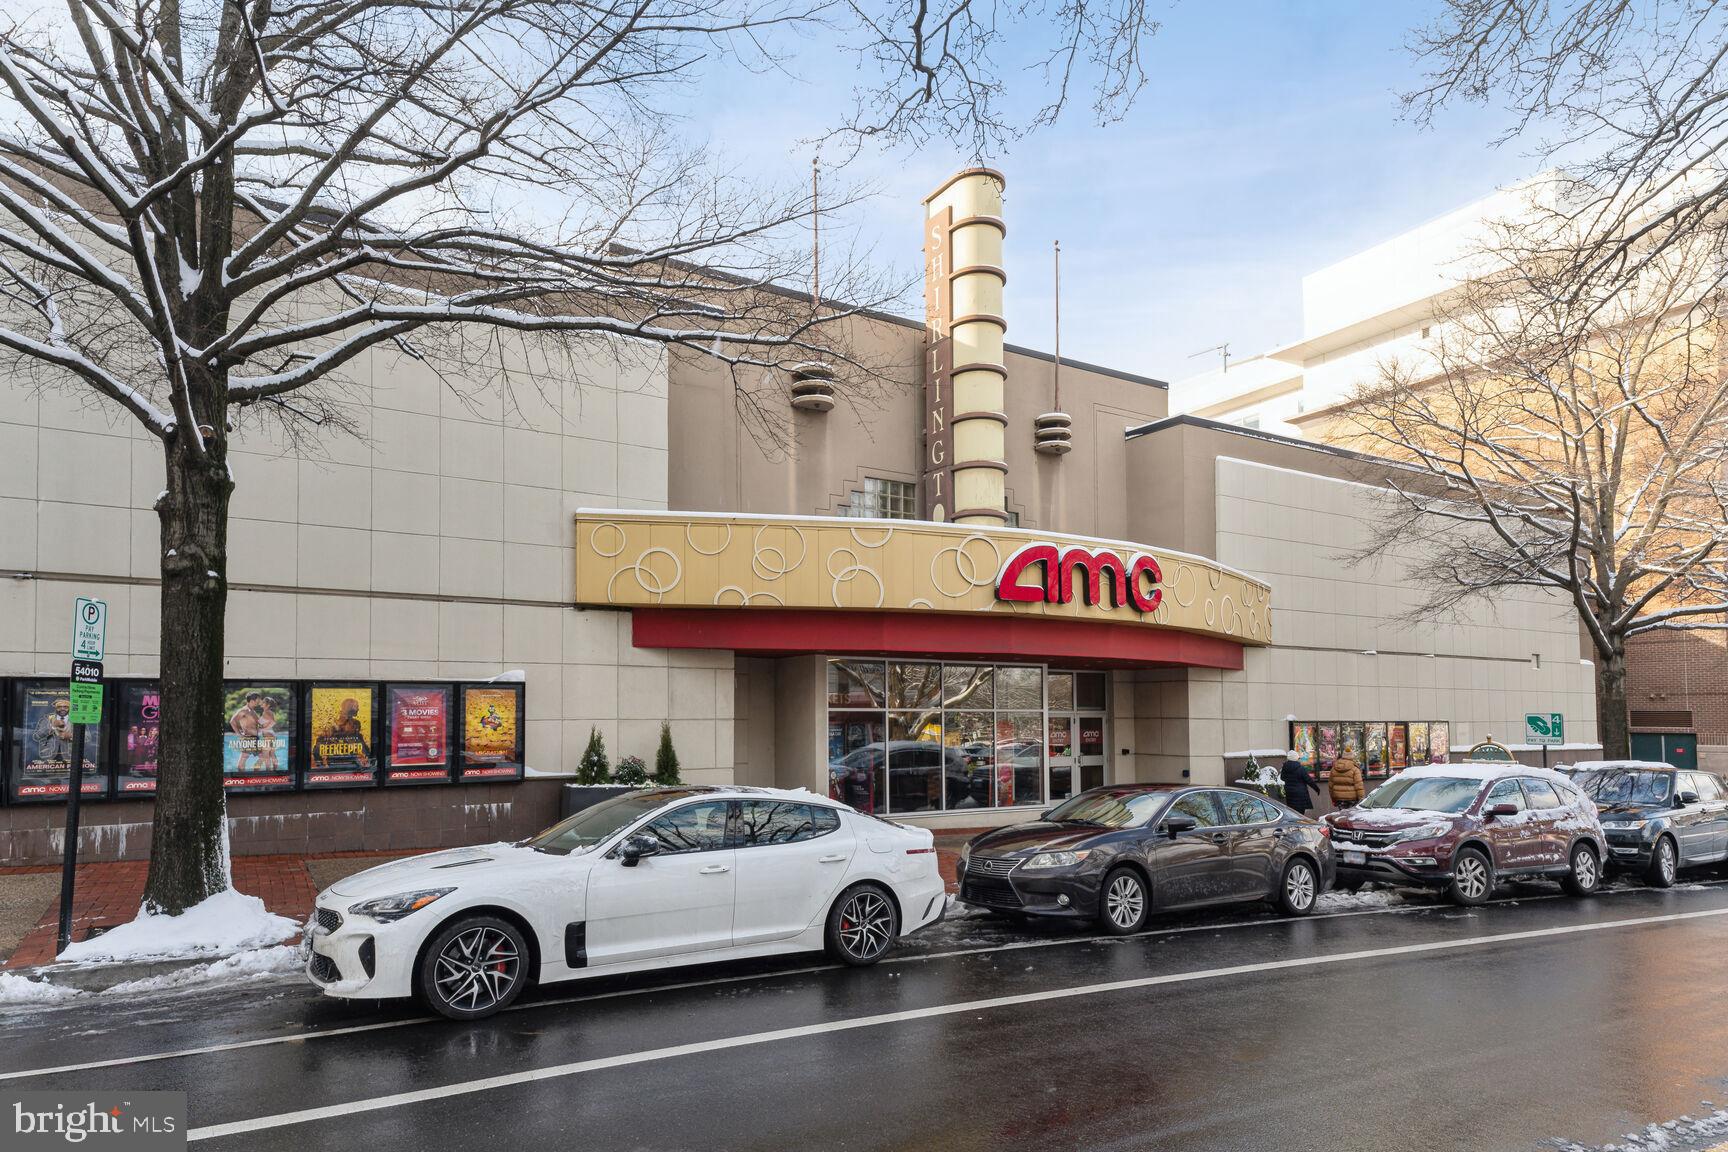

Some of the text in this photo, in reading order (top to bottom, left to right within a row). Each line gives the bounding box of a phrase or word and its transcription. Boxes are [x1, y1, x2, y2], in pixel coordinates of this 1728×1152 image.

[80, 631, 100, 641] PARKING
[81, 640, 86, 649] 4
[74, 666, 100, 677] 54010
[1552, 716, 1560, 724] 4
[229, 739, 286, 749] ANYONE BUT YOU
[319, 743, 363, 756] BEEKEEPER
